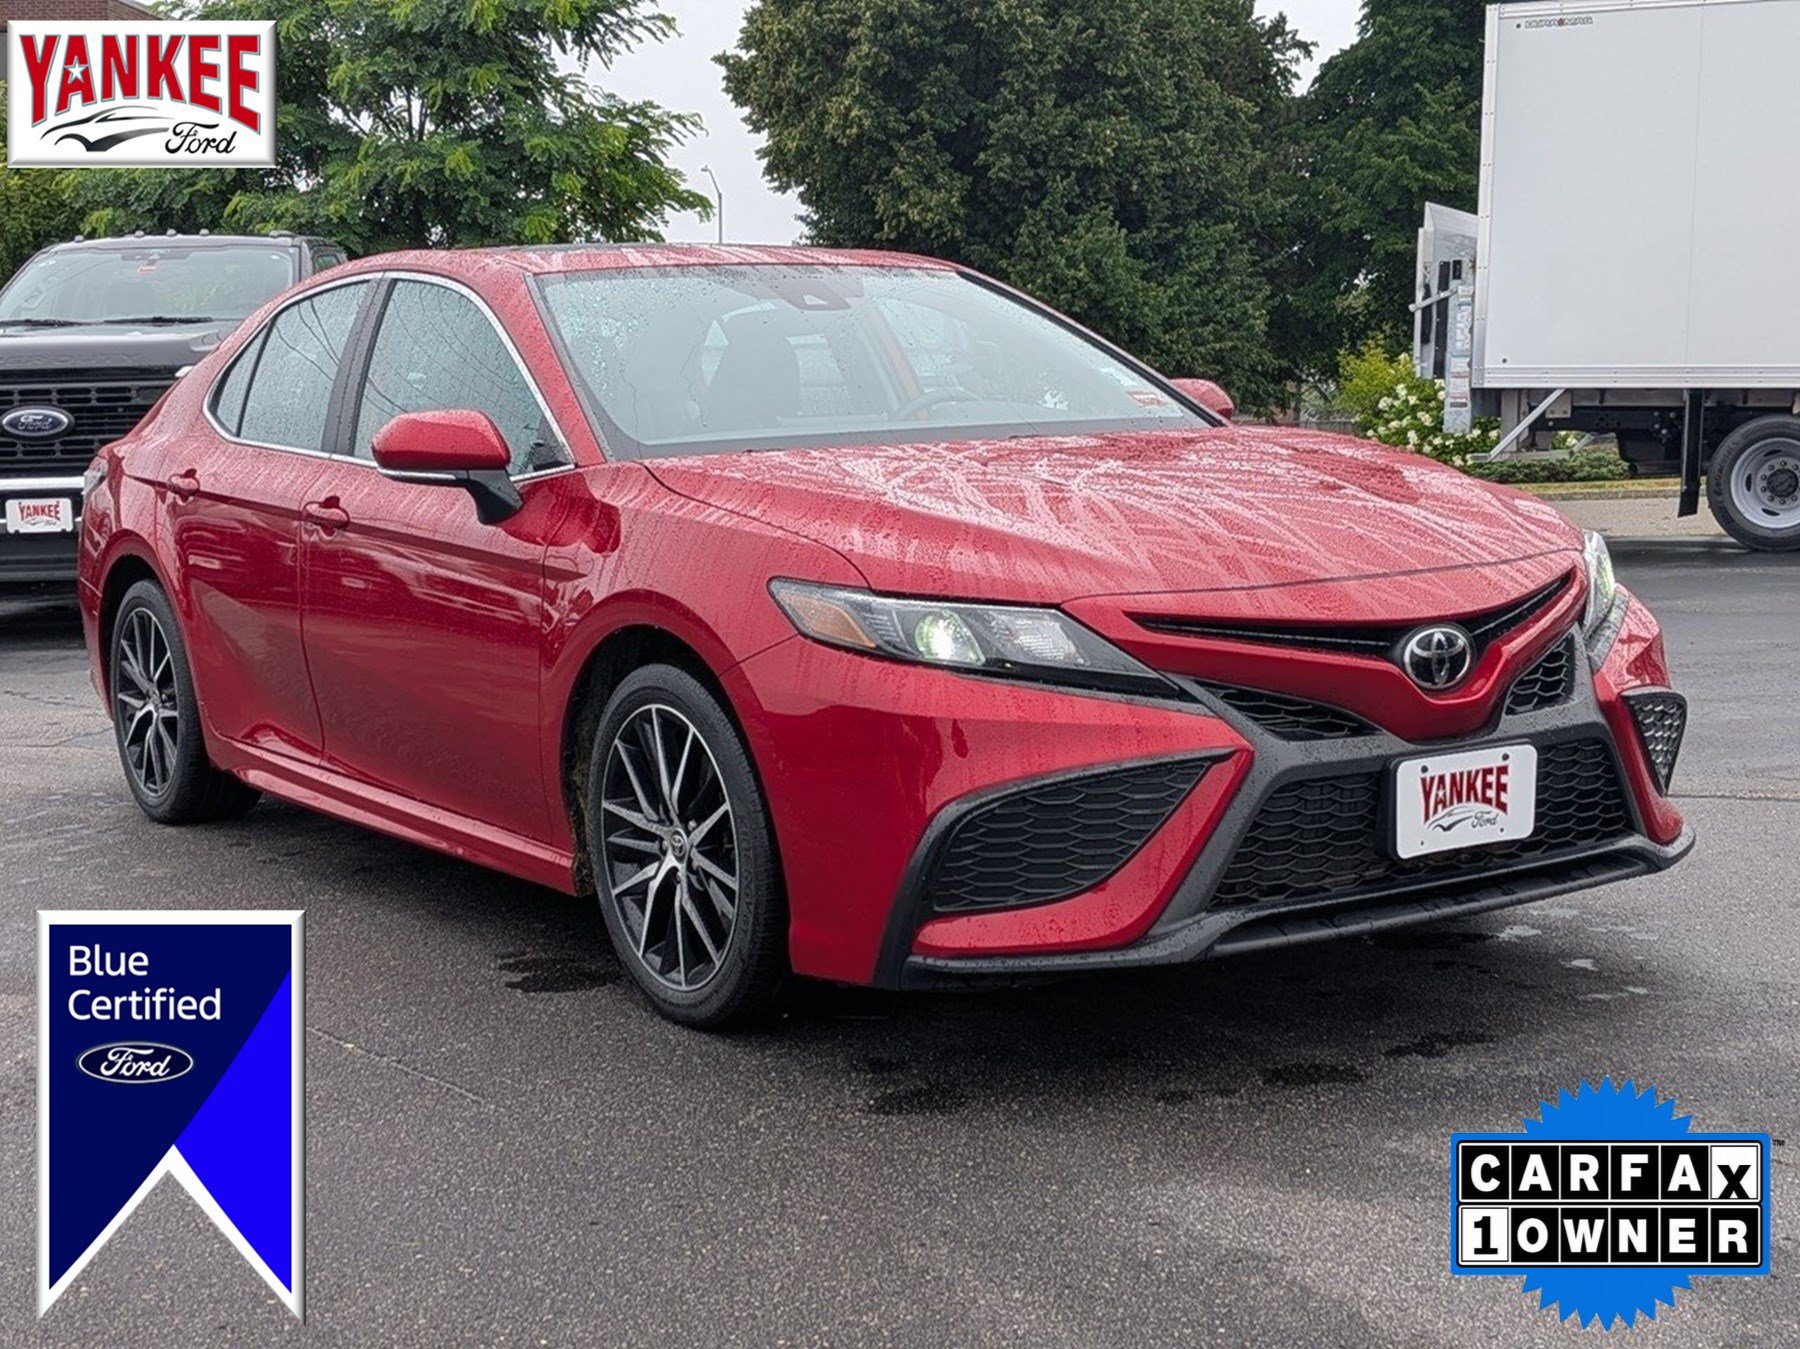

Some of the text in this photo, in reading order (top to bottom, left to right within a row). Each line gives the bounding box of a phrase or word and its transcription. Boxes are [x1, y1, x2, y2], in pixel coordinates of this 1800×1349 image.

[18, 414, 53, 430] Ford
[18, 503, 61, 521] YANKEE
[1420, 764, 1509, 825] YANKEE
[1471, 810, 1499, 829] Ford
